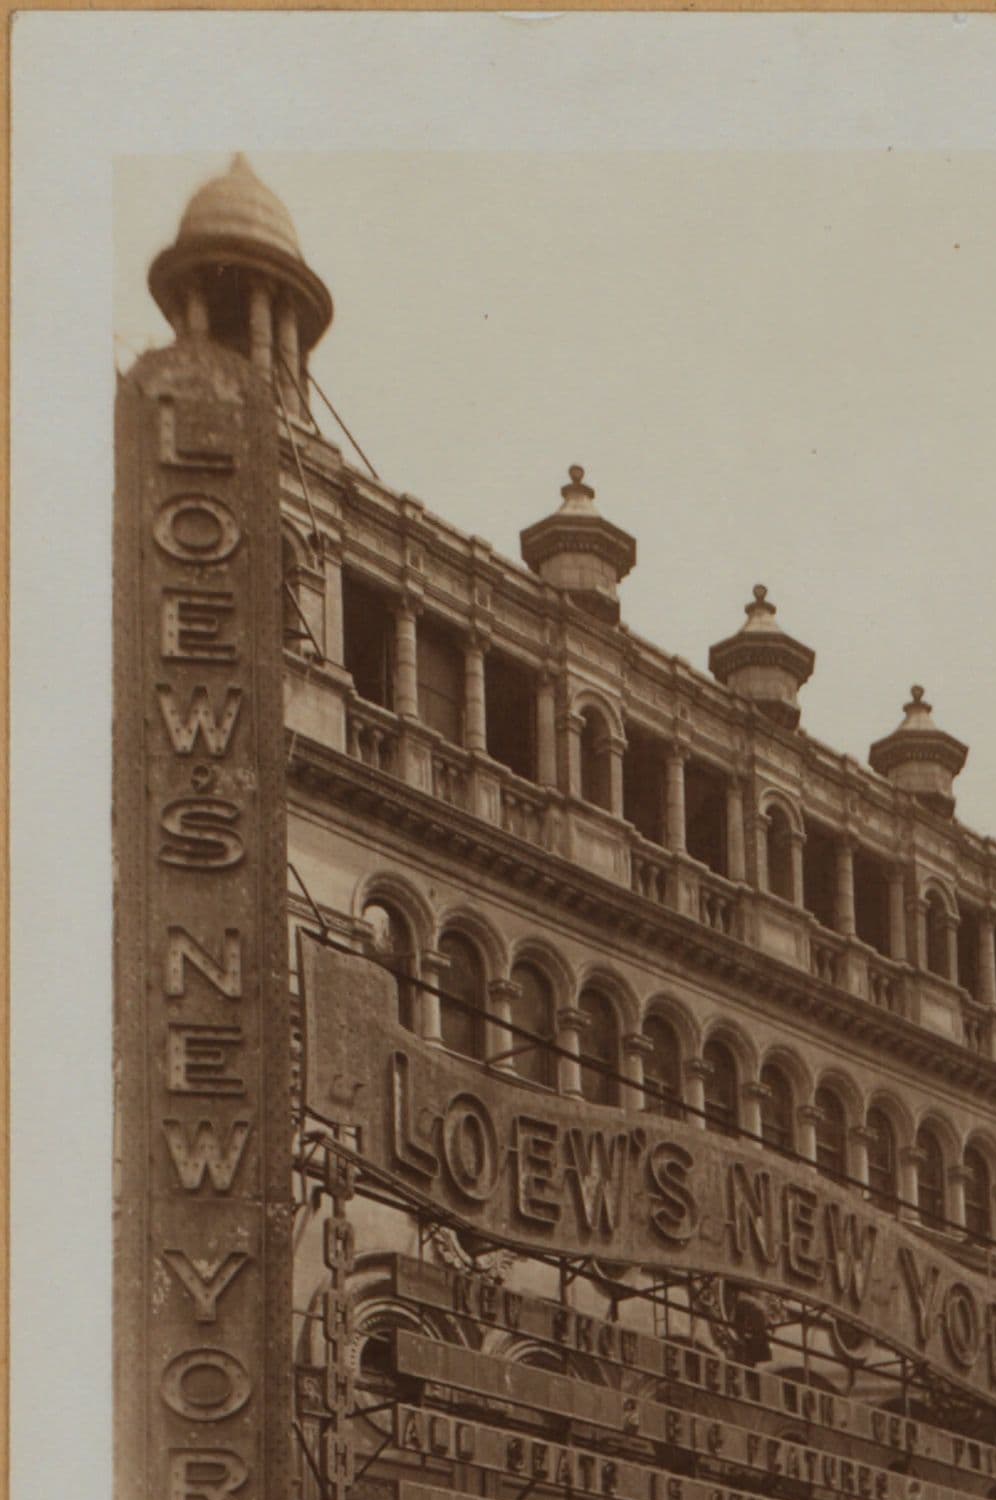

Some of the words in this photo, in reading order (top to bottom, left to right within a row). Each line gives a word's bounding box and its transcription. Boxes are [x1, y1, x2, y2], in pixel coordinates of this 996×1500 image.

[152, 394, 246, 872] LOEW'S
[161, 925, 252, 1193] NEW
[391, 1052, 698, 1244] LOEW'S
[726, 1160, 879, 1315] NEW
[401, 1410, 475, 1462] ALL
